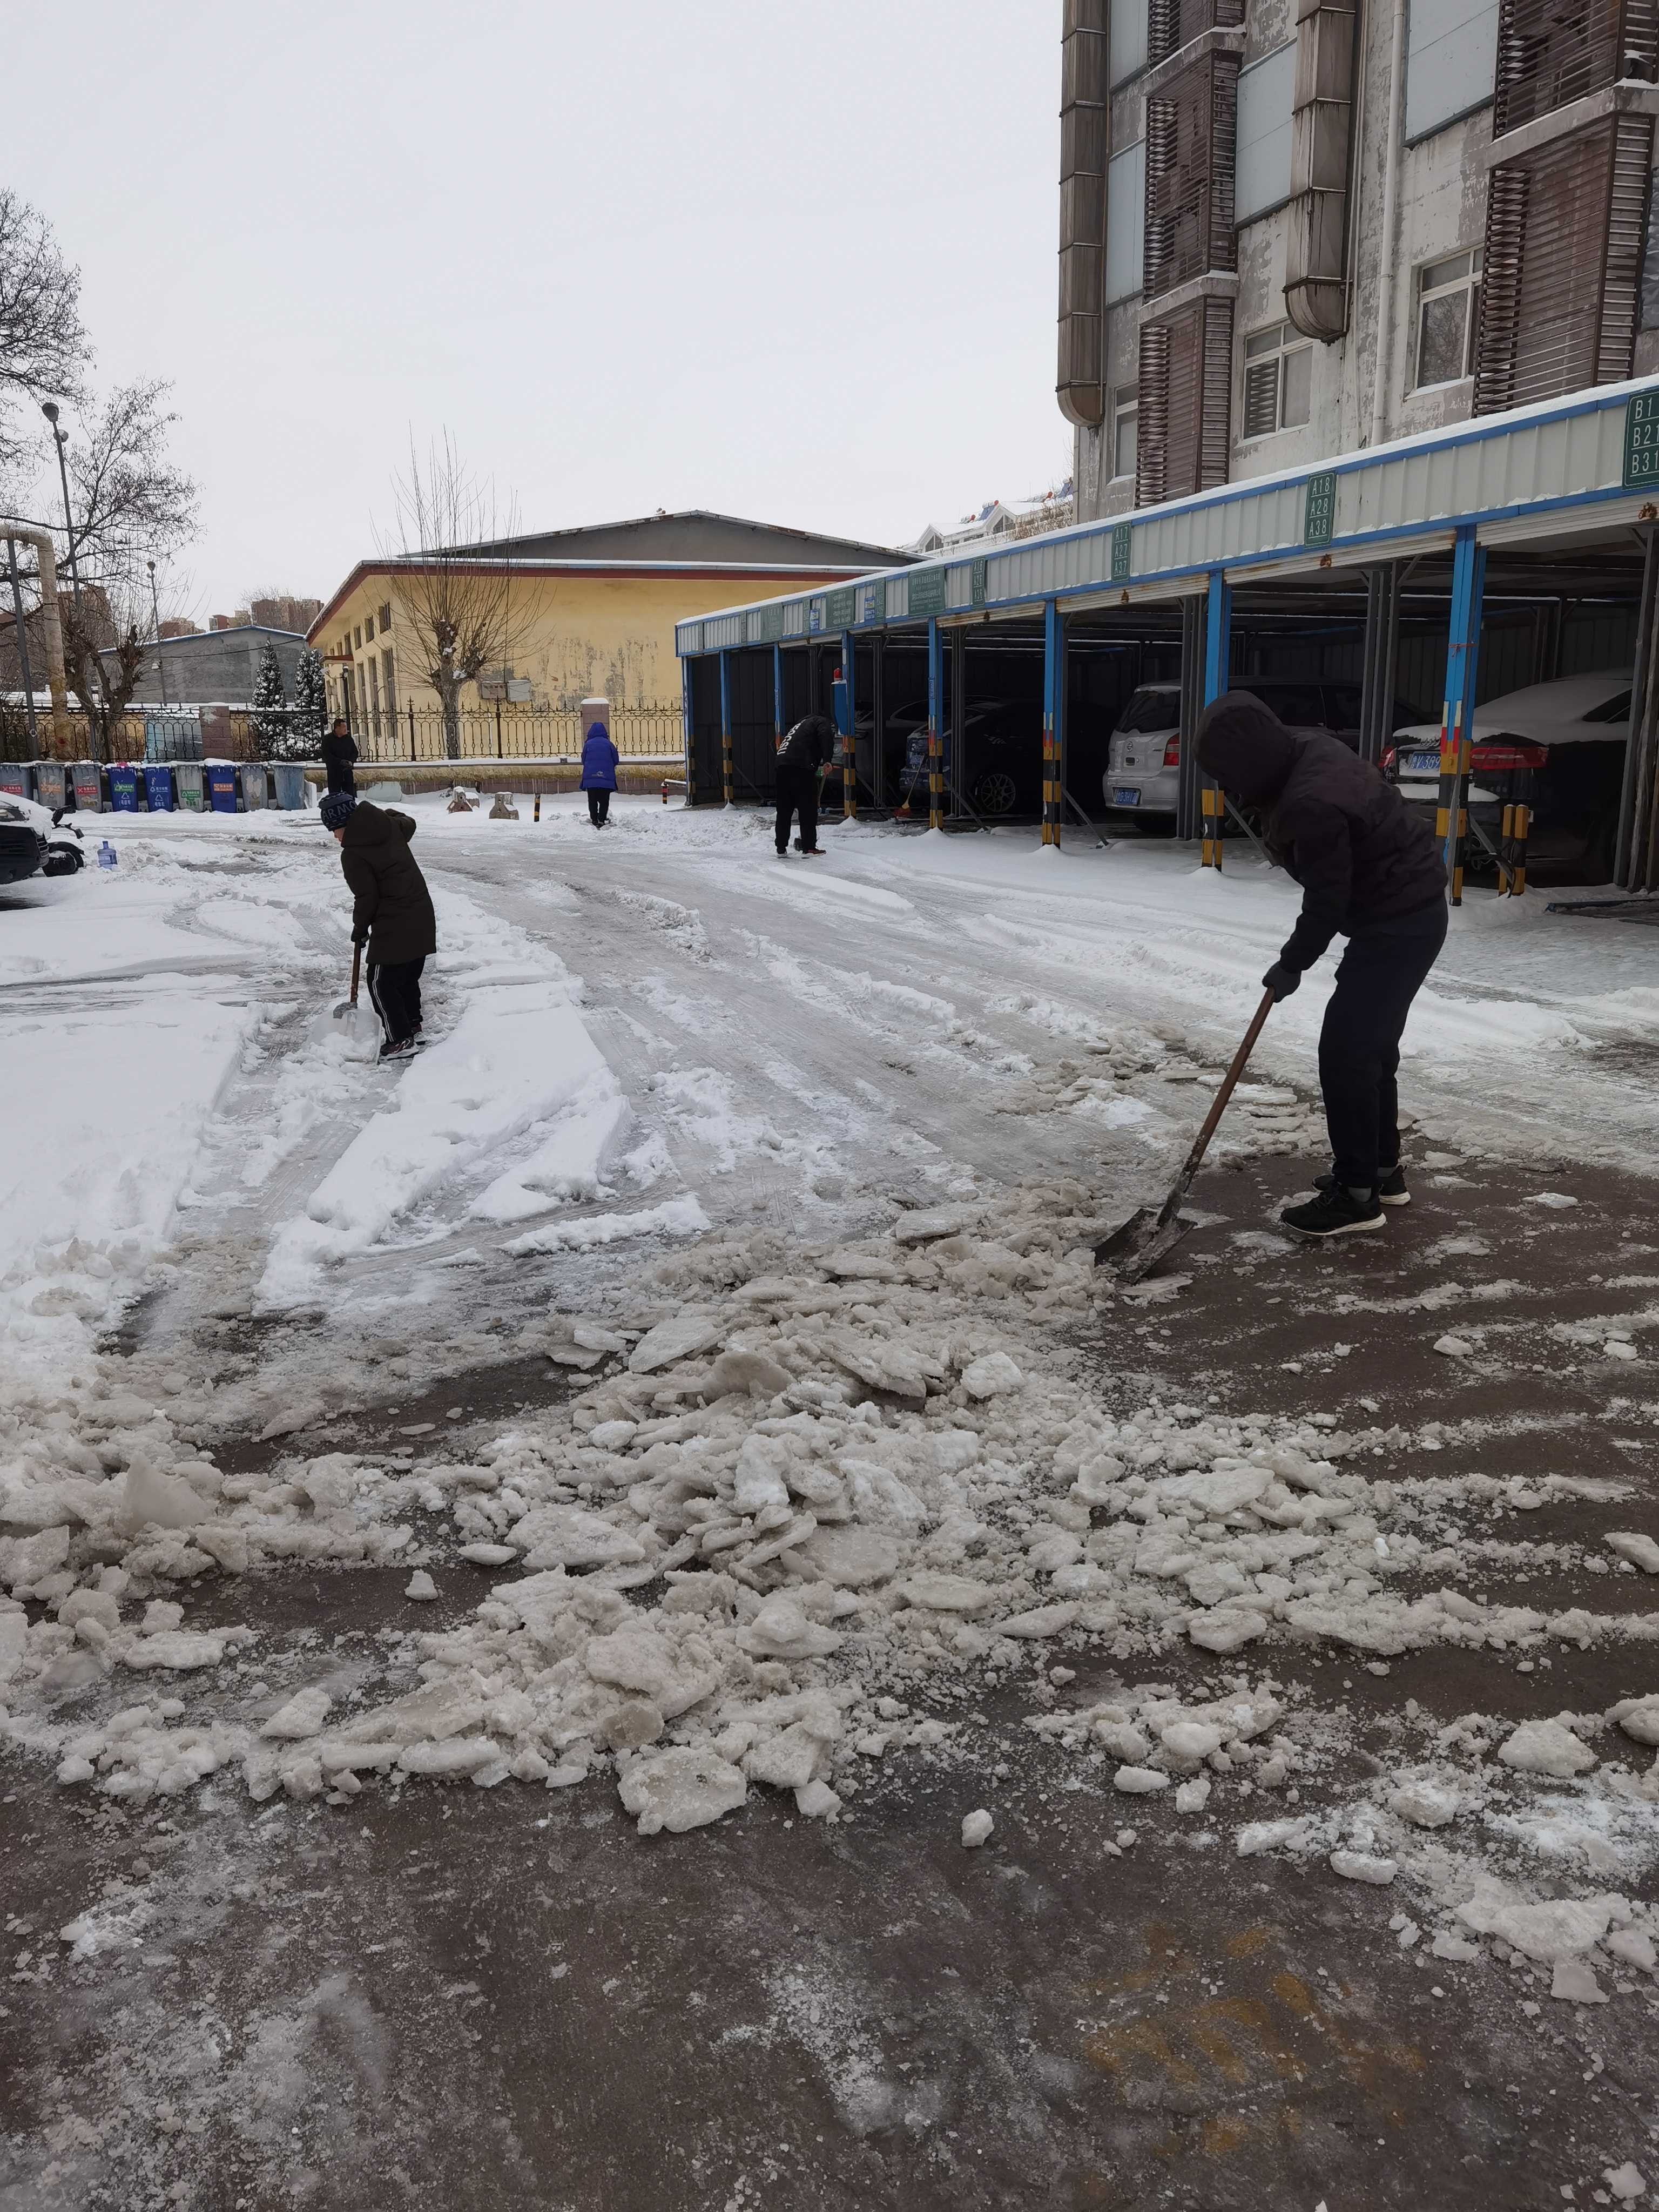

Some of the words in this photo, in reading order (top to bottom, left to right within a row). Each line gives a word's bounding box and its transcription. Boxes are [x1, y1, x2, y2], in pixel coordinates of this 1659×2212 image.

[1631, 450, 1659, 474] B31
[1312, 477, 1330, 495] A18
[1310, 498, 1328, 516] A28
[1115, 526, 1128, 541] A17
[1309, 519, 1327, 537] A38
[1115, 543, 1128, 557] A27
[974, 560, 983, 572] A16
[1114, 560, 1127, 575] A37
[974, 574, 982, 586] A26
[974, 588, 982, 600] A36
